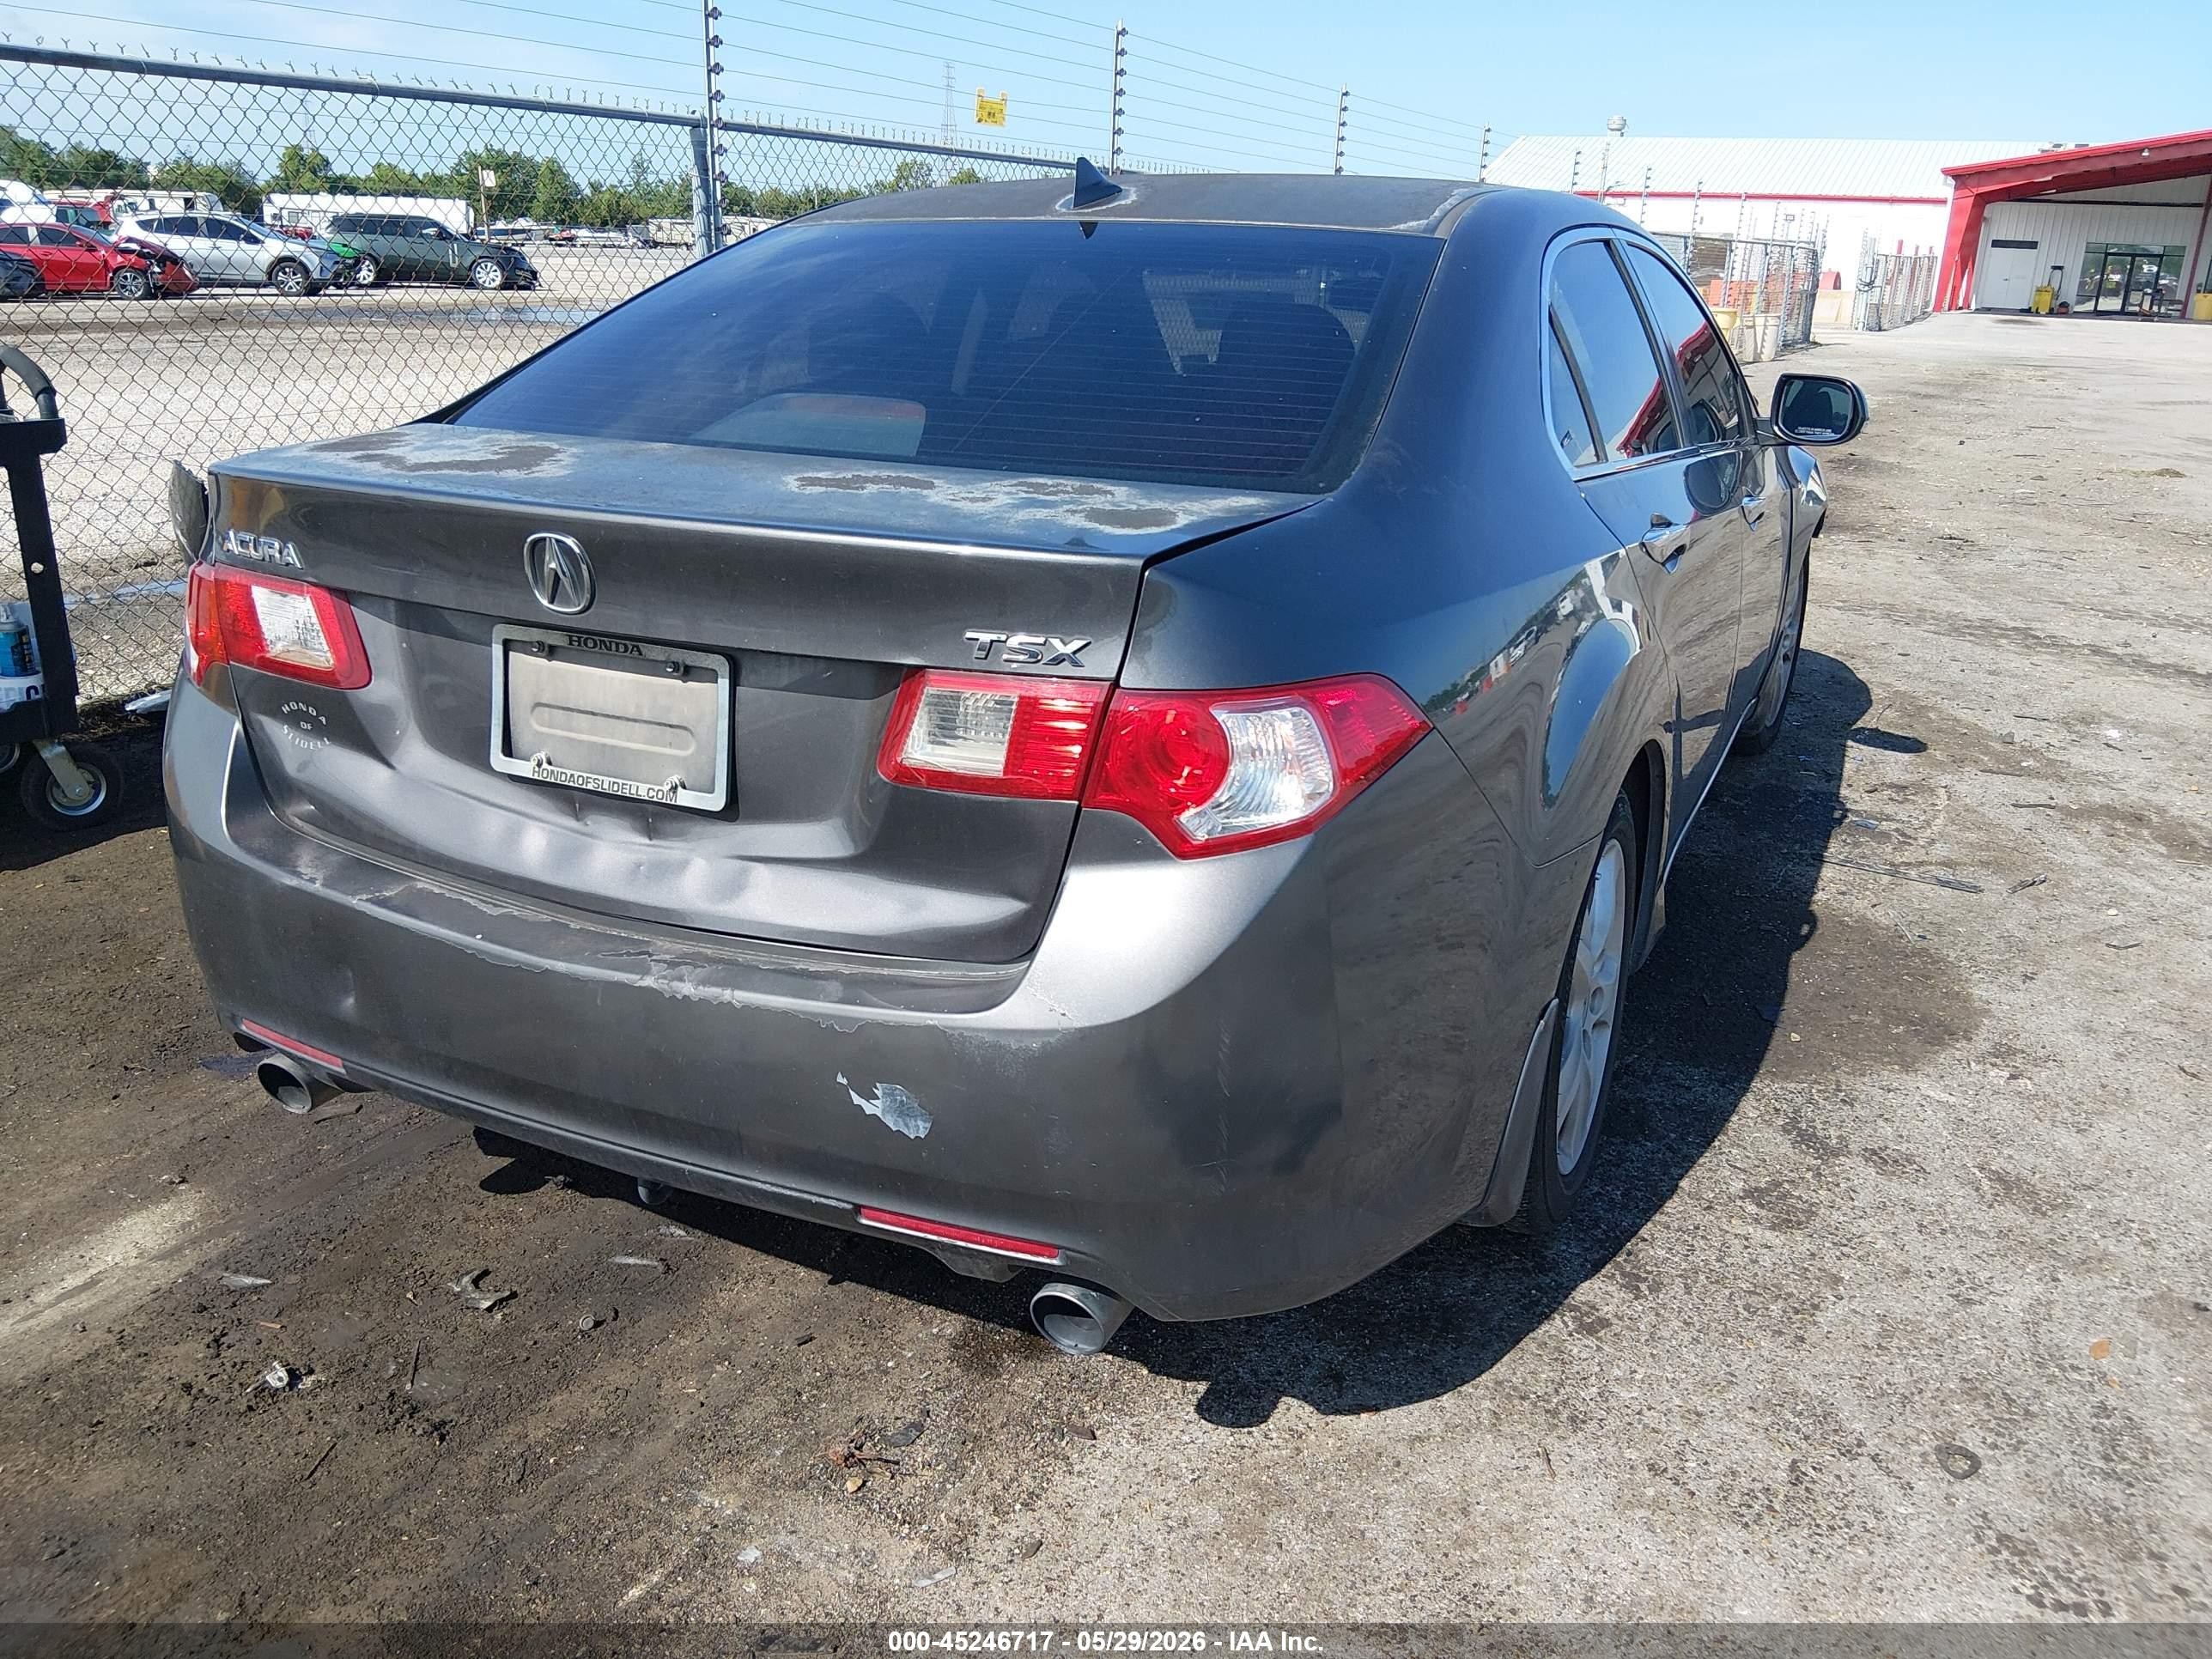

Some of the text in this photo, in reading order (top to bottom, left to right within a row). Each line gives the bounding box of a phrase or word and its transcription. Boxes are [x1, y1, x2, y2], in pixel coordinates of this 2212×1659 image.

[223, 529, 304, 570] ACURA
[567, 635, 643, 657] HONDA
[964, 629, 1092, 667] TSX
[281, 702, 326, 725] HONDA
[300, 721, 313, 731] OF
[281, 725, 331, 750] SLIDELL
[532, 766, 678, 804] HONDAOFSLIDELL.COM
